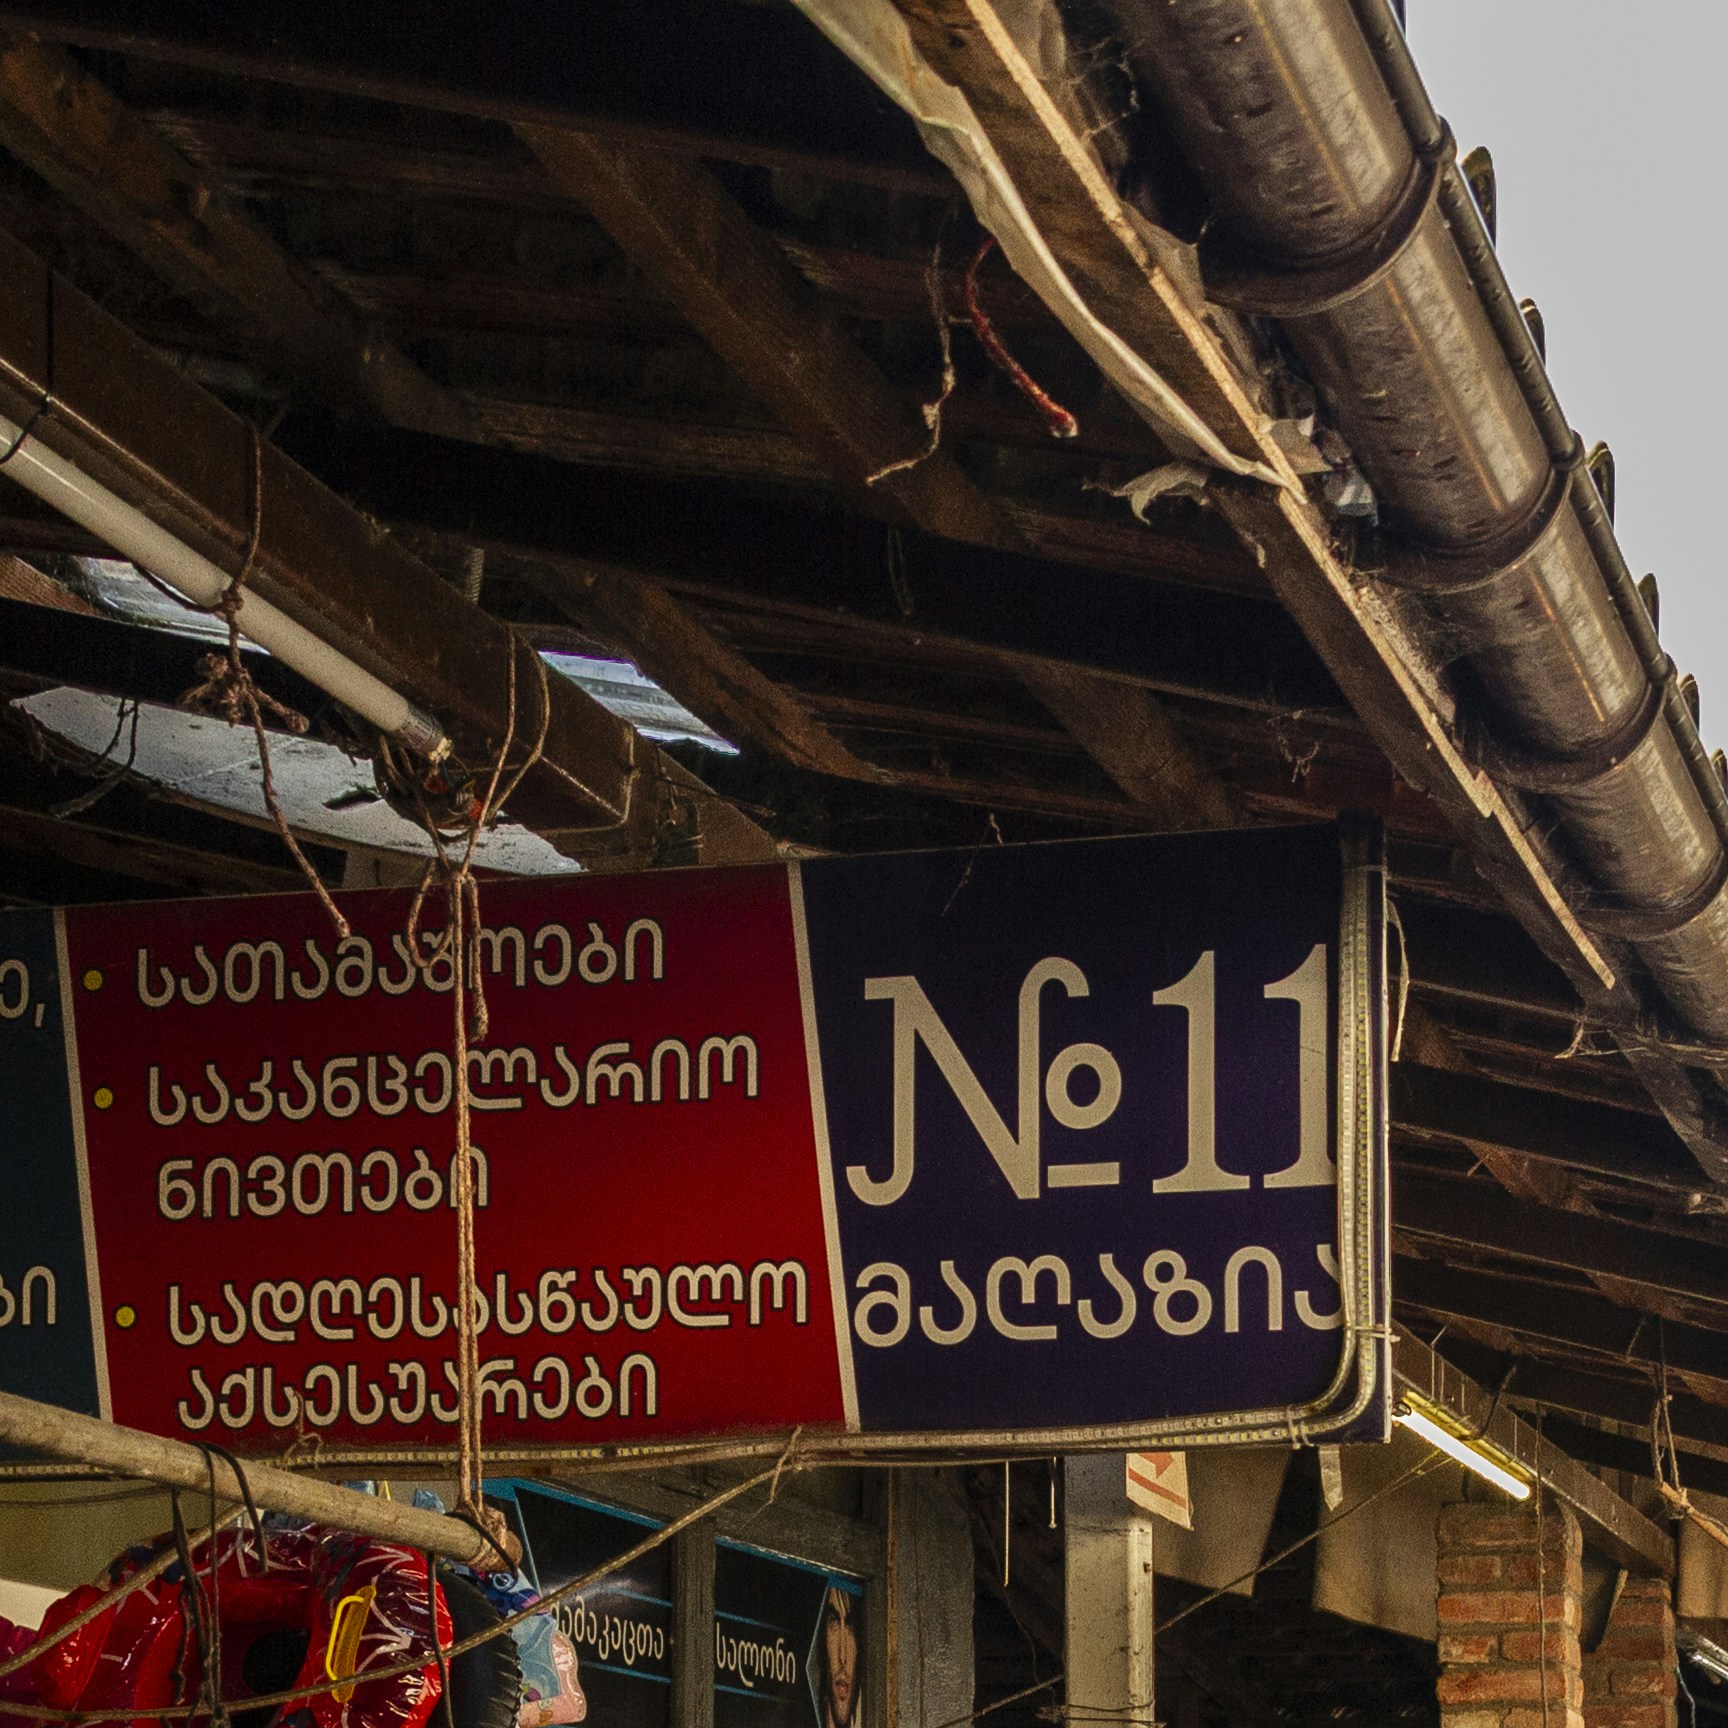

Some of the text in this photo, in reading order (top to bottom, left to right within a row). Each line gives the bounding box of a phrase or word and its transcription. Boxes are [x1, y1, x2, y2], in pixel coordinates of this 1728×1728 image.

[138, 918, 664, 1006] სათამაშოები
[149, 1034, 760, 1124] საკანცელარიო
[158, 1145, 489, 1219] ნივთები
[168, 1259, 808, 1345] სადღესასწაულო
[854, 1243, 1346, 1348] მაღაზია
[178, 1352, 658, 1430] აქსესუარები
[716, 1621, 796, 1688] სალონი
